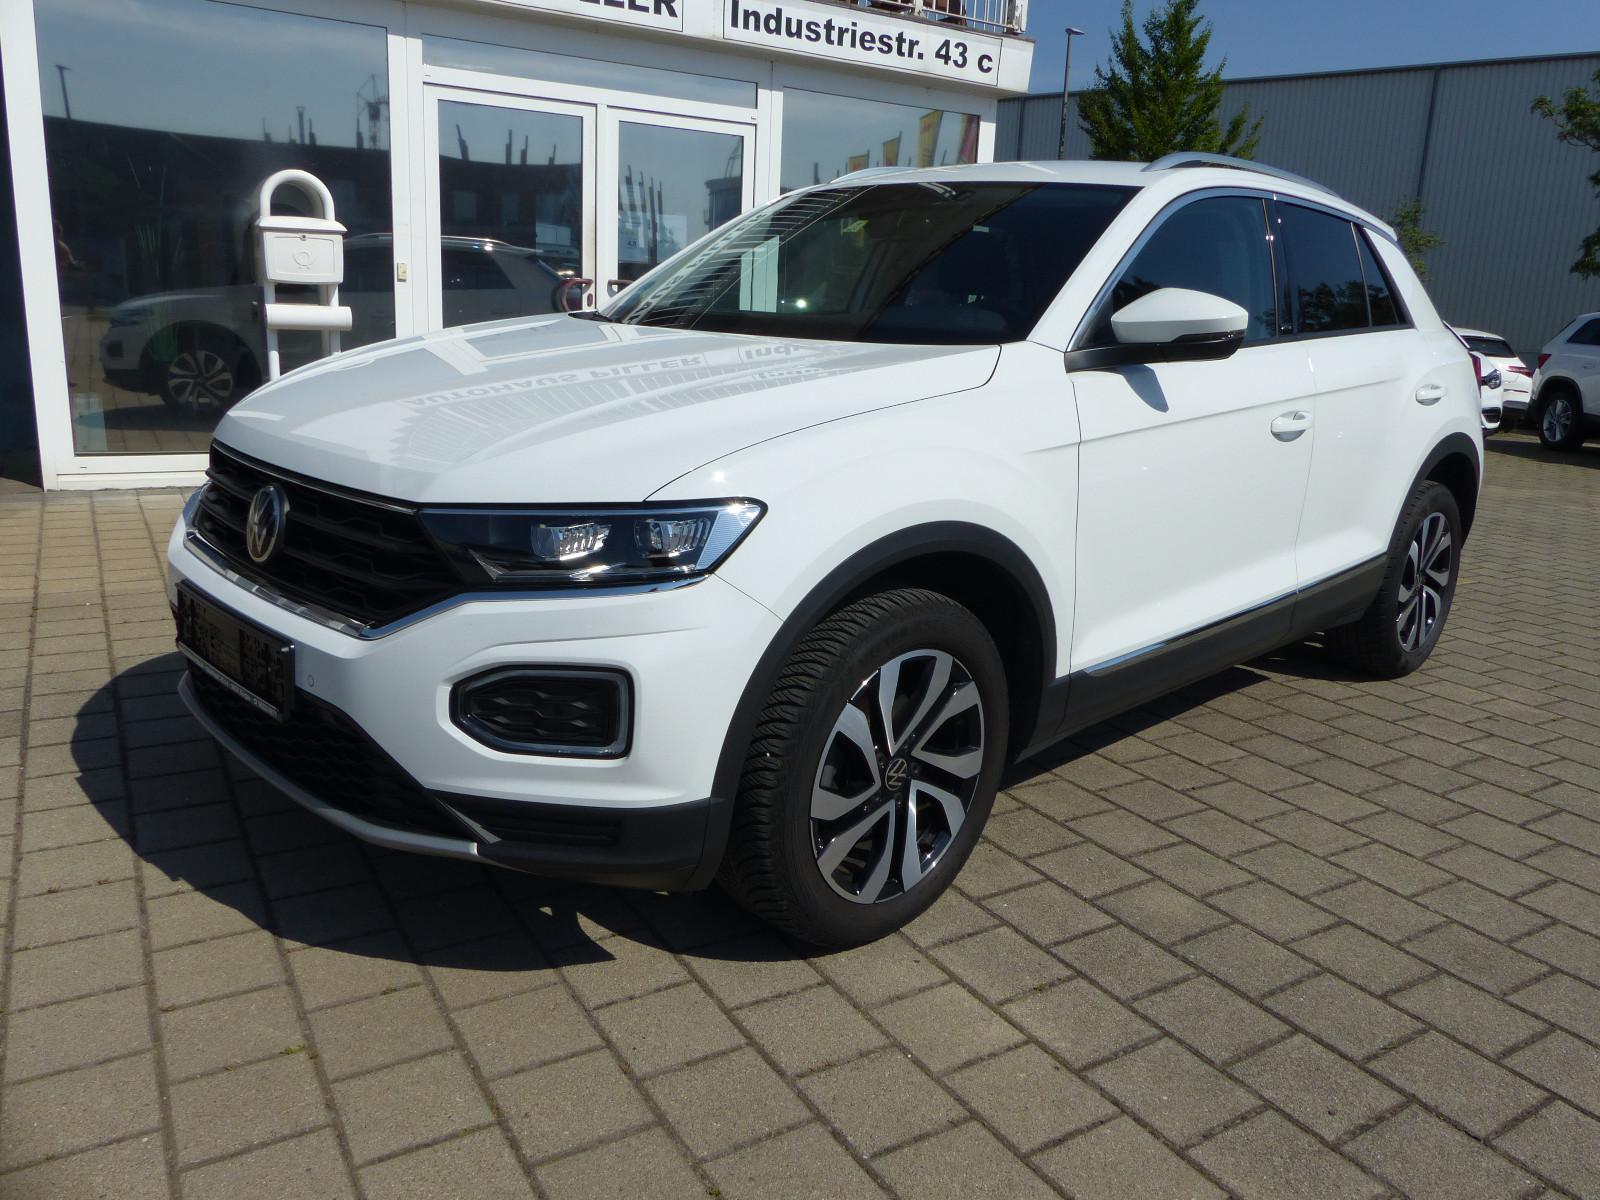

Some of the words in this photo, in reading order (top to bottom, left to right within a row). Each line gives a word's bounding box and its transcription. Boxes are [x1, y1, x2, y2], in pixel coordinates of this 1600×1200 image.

[731, 0, 924, 60] Industriestr.
[935, 39, 968, 69] 43
[977, 54, 993, 74] c
